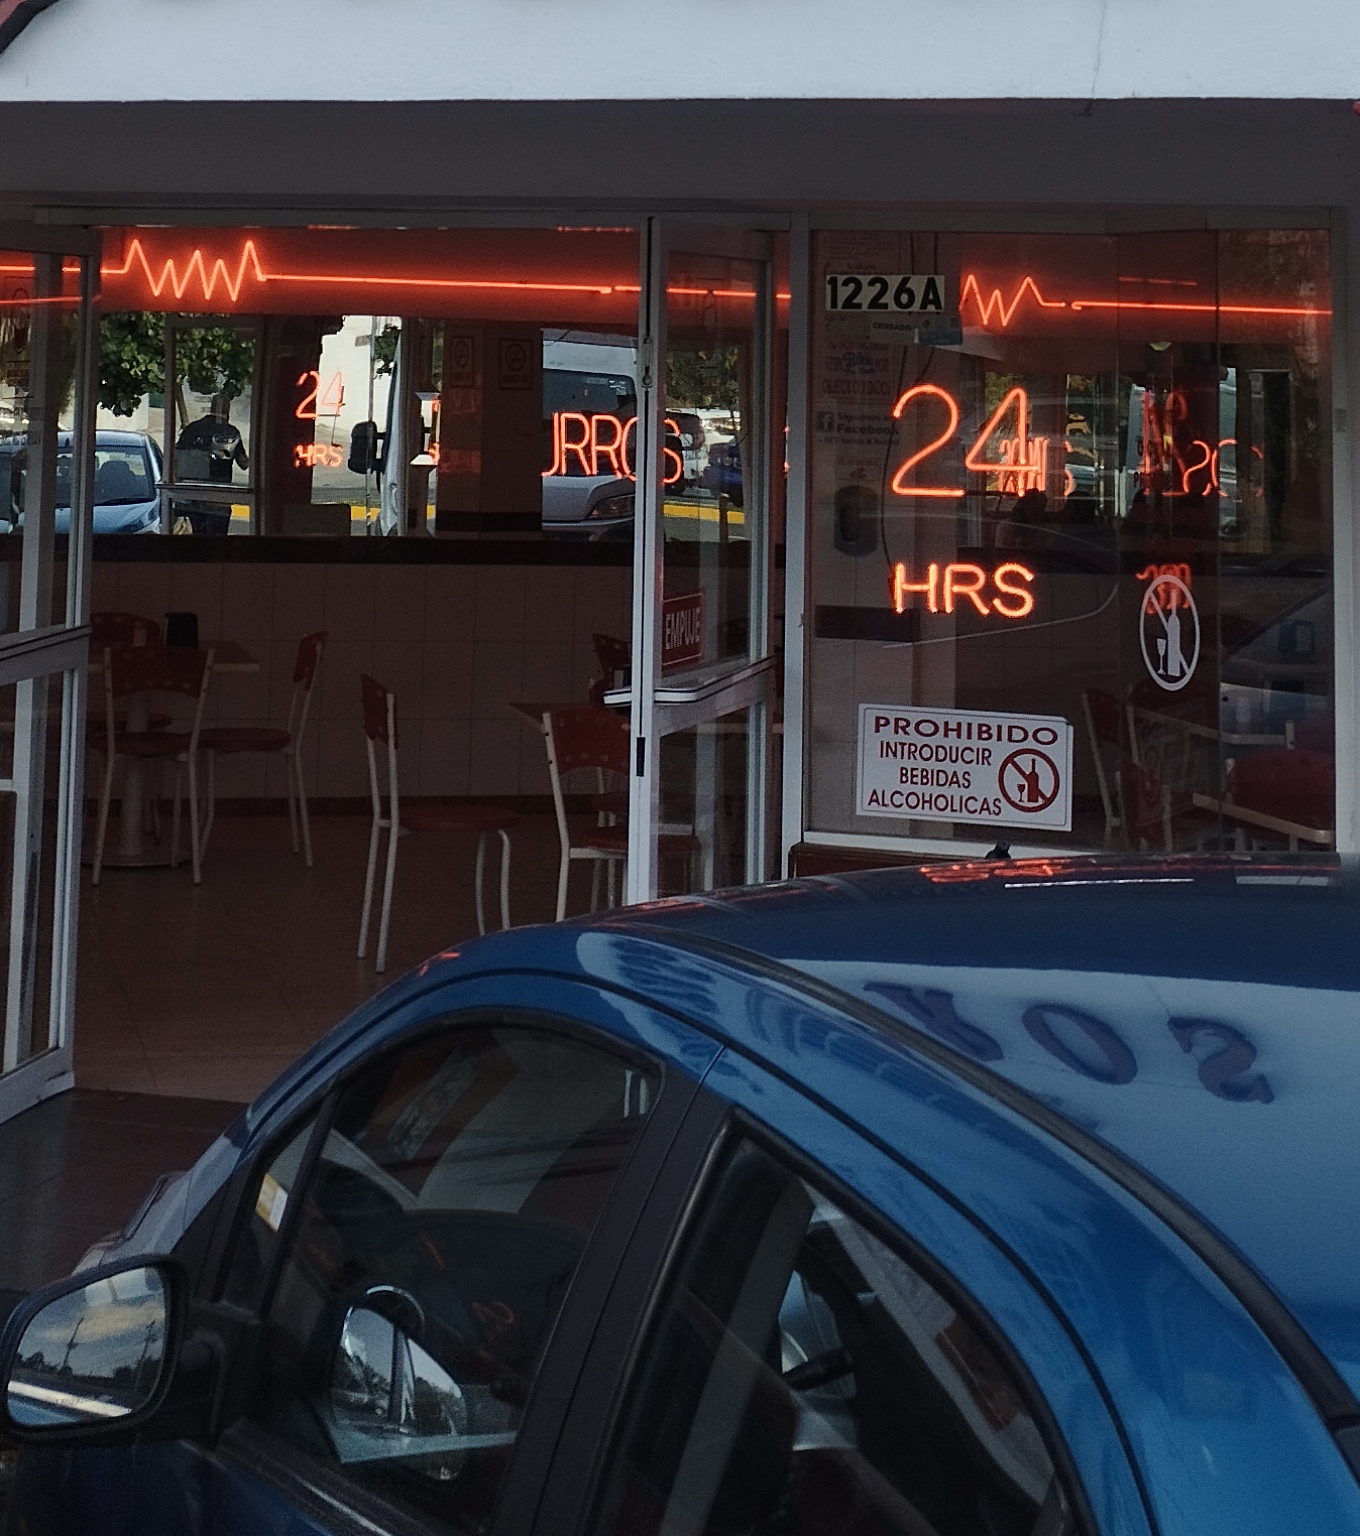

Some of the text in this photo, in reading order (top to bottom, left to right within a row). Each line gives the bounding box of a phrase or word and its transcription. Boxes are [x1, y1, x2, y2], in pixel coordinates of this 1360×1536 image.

[827, 275, 943, 311] 1226A
[872, 322, 912, 331] CENSADO
[891, 383, 1042, 499] 24
[890, 562, 1035, 619] HRS
[874, 715, 1059, 746] PROHIBIDO
[879, 740, 993, 767] INTRODUCIR
[899, 766, 972, 790] BEBIDAS
[867, 788, 1003, 817] ALCOHOLICAS
